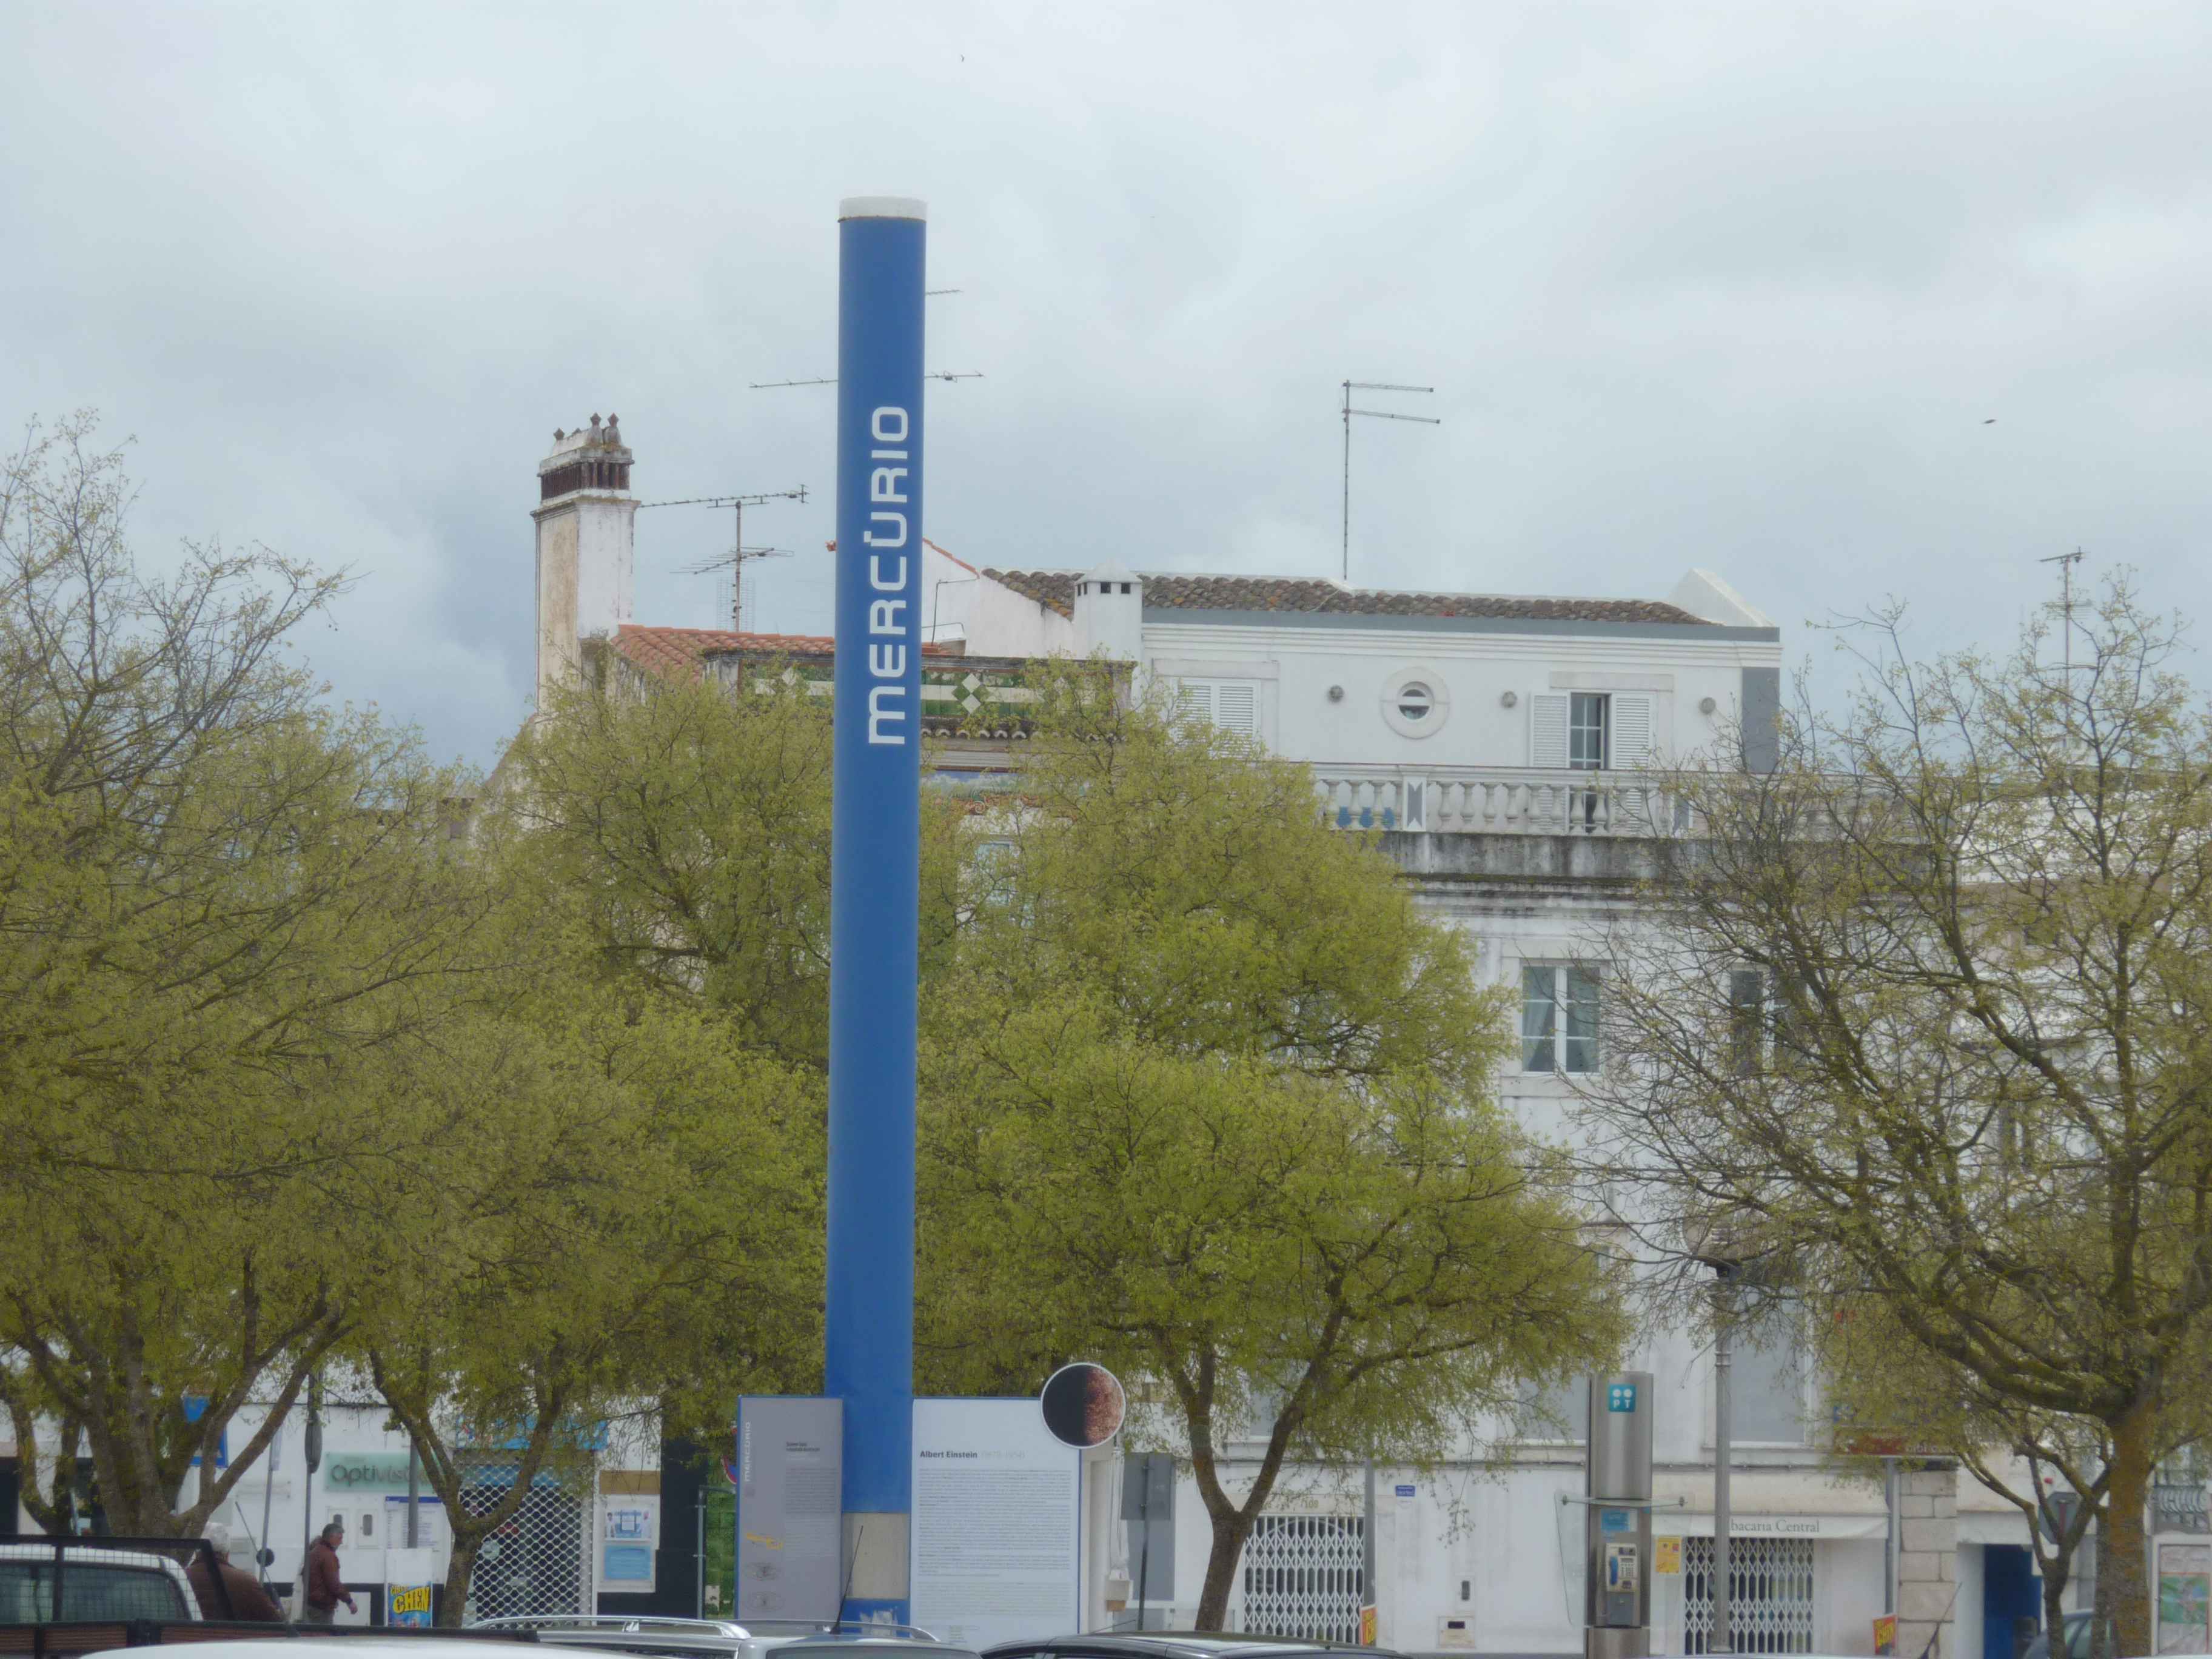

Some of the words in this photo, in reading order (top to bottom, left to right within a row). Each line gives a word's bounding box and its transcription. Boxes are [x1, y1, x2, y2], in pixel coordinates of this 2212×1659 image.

[920, 1450, 944, 1459] Albert
[946, 1450, 978, 1459] Einstein
[1731, 1518, 1771, 1532] bacaria
[1775, 1518, 1820, 1533] Central
[393, 1586, 430, 1614] CHEN
